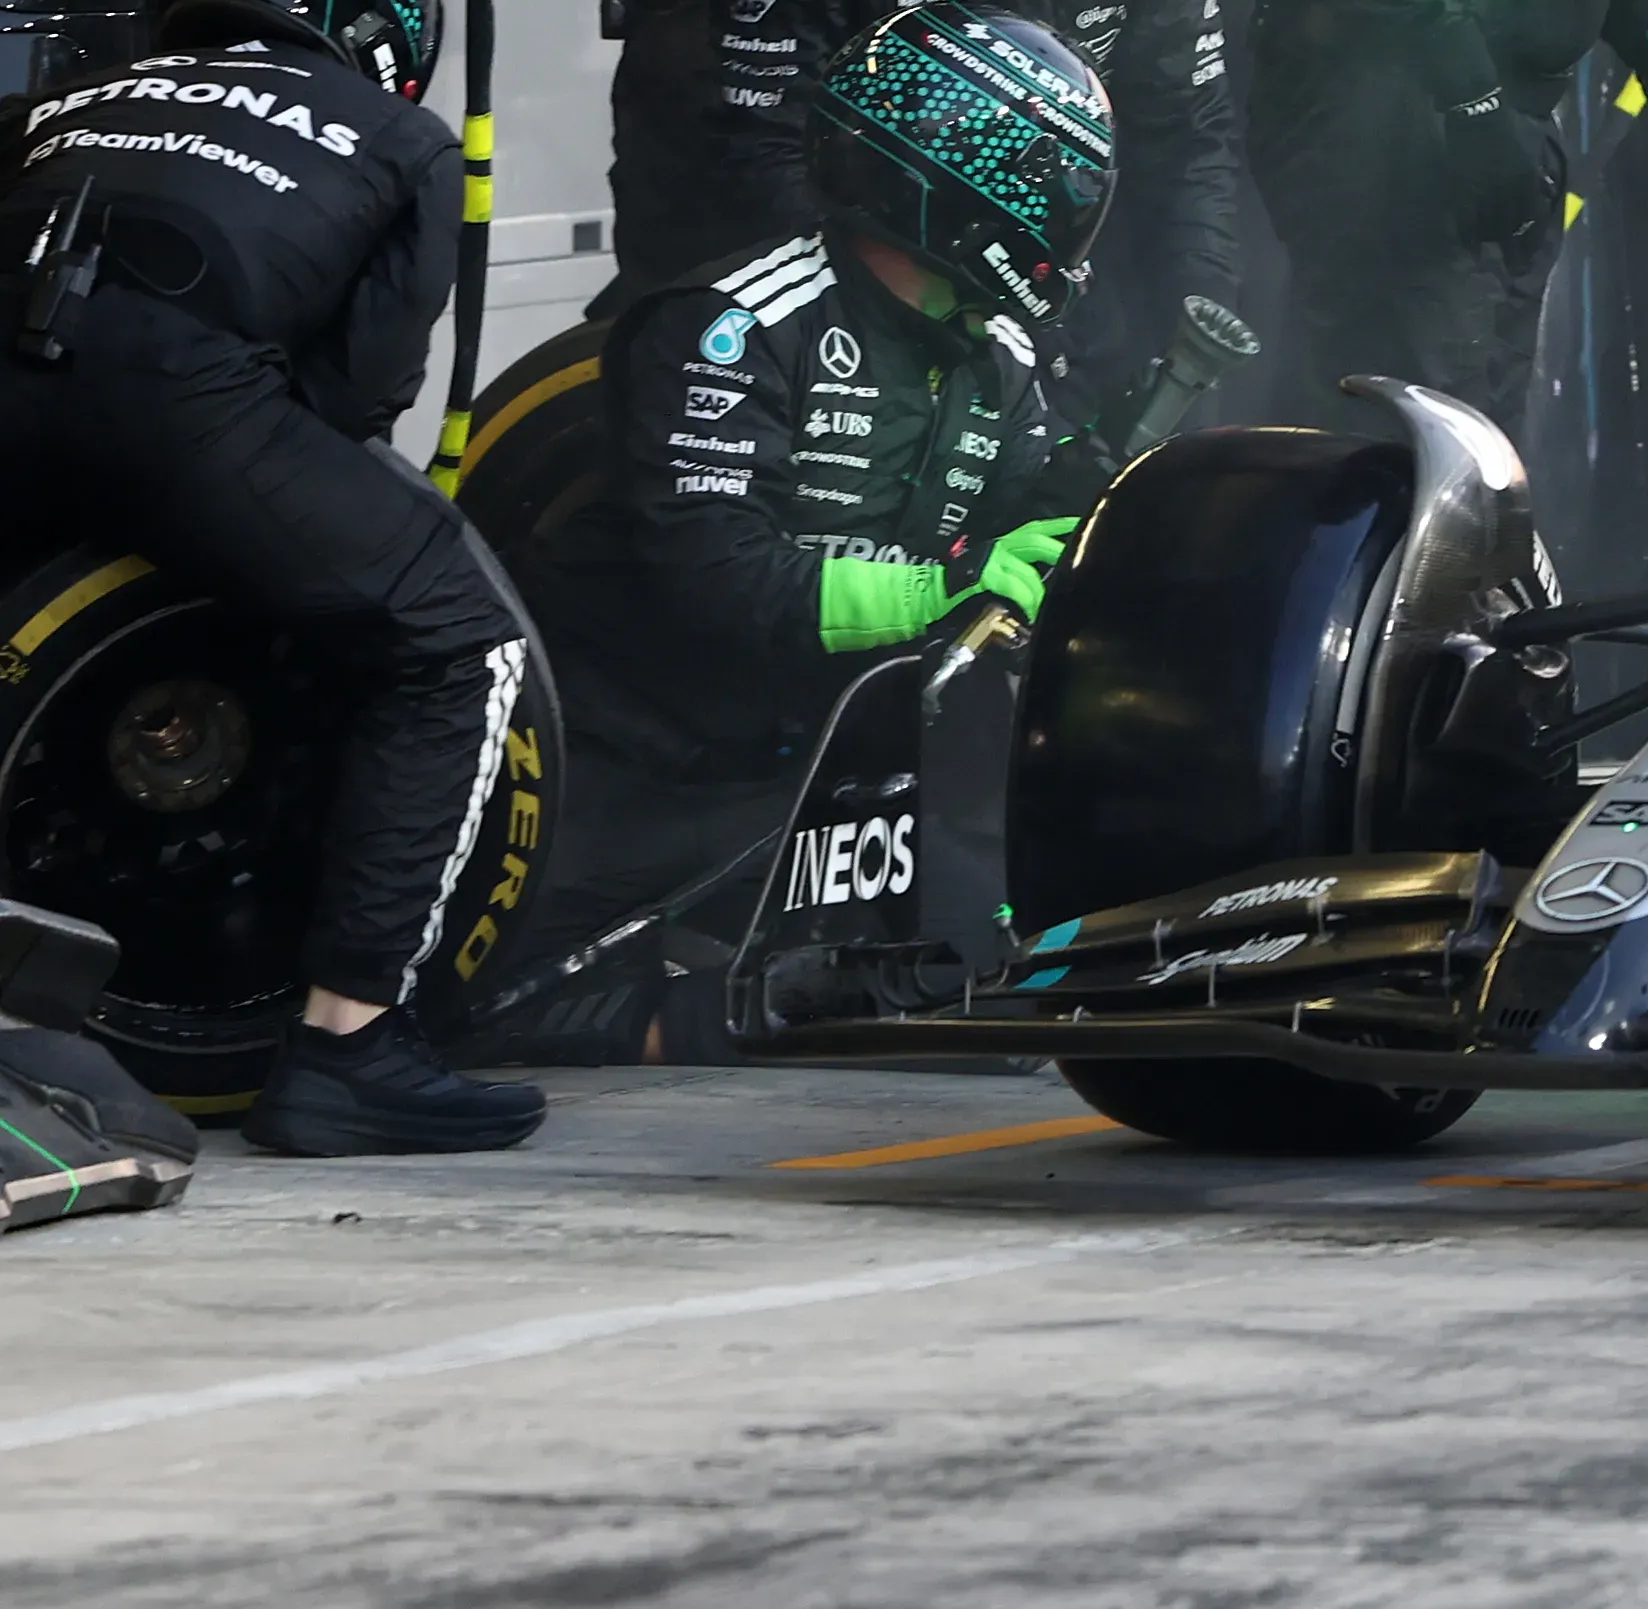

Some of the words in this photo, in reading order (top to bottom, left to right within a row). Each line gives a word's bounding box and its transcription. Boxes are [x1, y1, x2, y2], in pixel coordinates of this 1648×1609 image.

[926, 33, 1029, 101] CROWDSTRIKE
[989, 40, 1086, 109] SOLERA
[25, 76, 362, 158] PETRONAS
[60, 127, 299, 195] TeamViewer
[981, 241, 1052, 320] Einhell
[687, 392, 730, 414] SAP
[831, 411, 874, 437] UBS
[667, 432, 757, 455] Einhell
[675, 474, 749, 496] nuvei
[454, 727, 543, 982] ZERO
[783, 813, 915, 913] INEOS
[1197, 876, 1339, 920] PETRONAS
